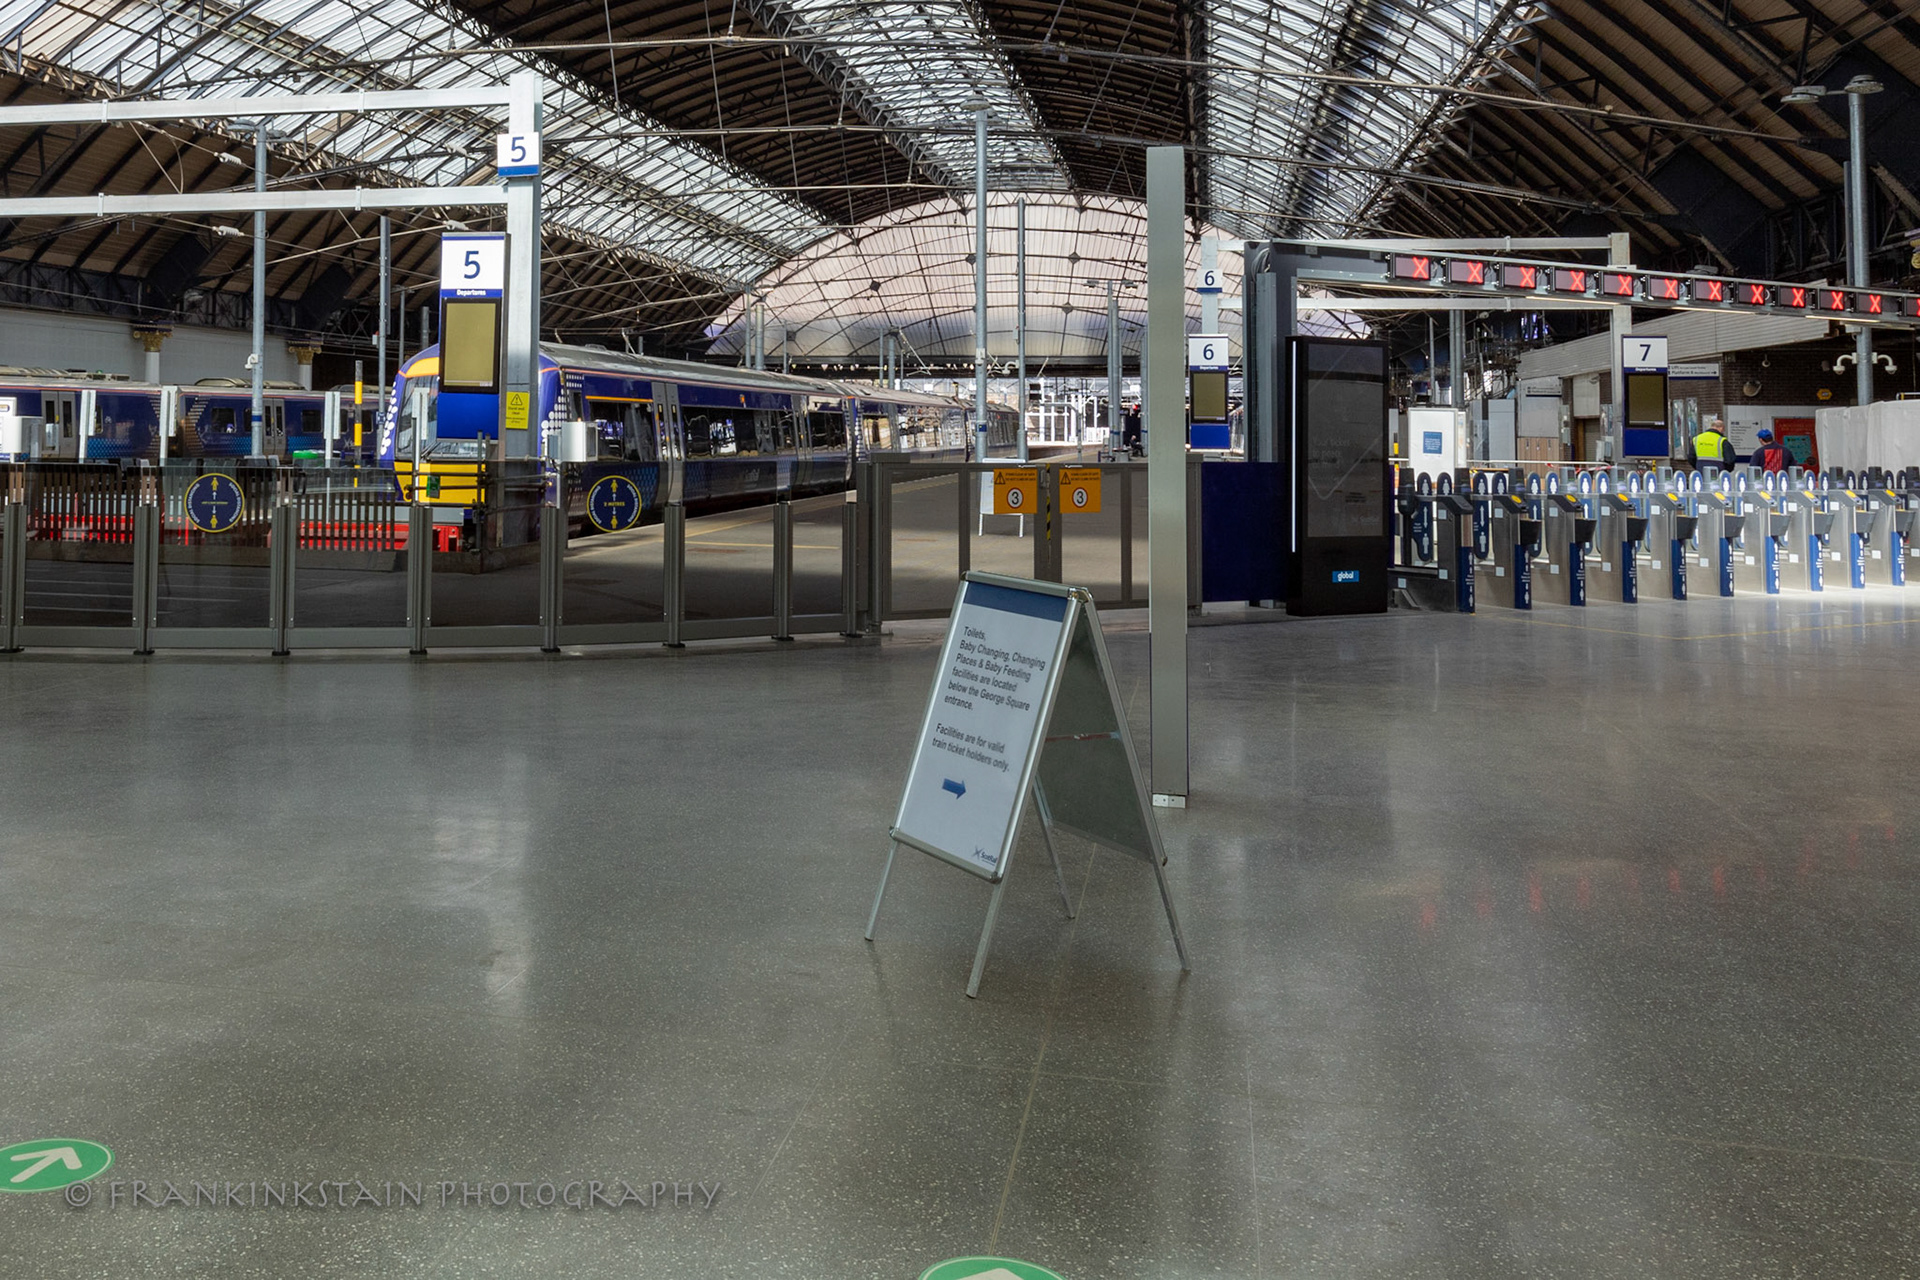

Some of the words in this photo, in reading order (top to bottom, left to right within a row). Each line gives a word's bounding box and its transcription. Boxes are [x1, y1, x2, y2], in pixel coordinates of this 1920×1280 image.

[511, 136, 526, 162] 5
[464, 250, 481, 279] 5
[1204, 270, 1215, 286] 6
[456, 289, 487, 297] Departures
[1203, 343, 1214, 361] 6
[1640, 344, 1651, 361] 7
[1012, 491, 1019, 504] 3
[1077, 491, 1084, 504] 3
[1337, 571, 1354, 582] global
[964, 626, 986, 641] Toilets,
[960, 639, 976, 654] Baby
[977, 644, 1010, 663] Changing,
[1012, 652, 1046, 671] Changing
[956, 653, 977, 667] Places
[978, 659, 983, 668] &
[985, 660, 1003, 675] Baby
[1003, 665, 1032, 683] Feeding
[952, 666, 979, 682] facilities
[979, 675, 991, 685] are
[991, 677, 1018, 692] located
[944, 695, 973, 710] entrance.
[948, 680, 968, 693] below
[968, 686, 979, 697] the
[980, 688, 1005, 705] George
[1005, 695, 1031, 711] Square
[936, 723, 965, 741] Facilities
[964, 735, 976, 744] are
[976, 736, 987, 748] for
[987, 741, 1006, 754] valid
[932, 737, 948, 750] train
[947, 743, 966, 756] ticket
[966, 747, 992, 765] holders
[992, 759, 1010, 773] only.
